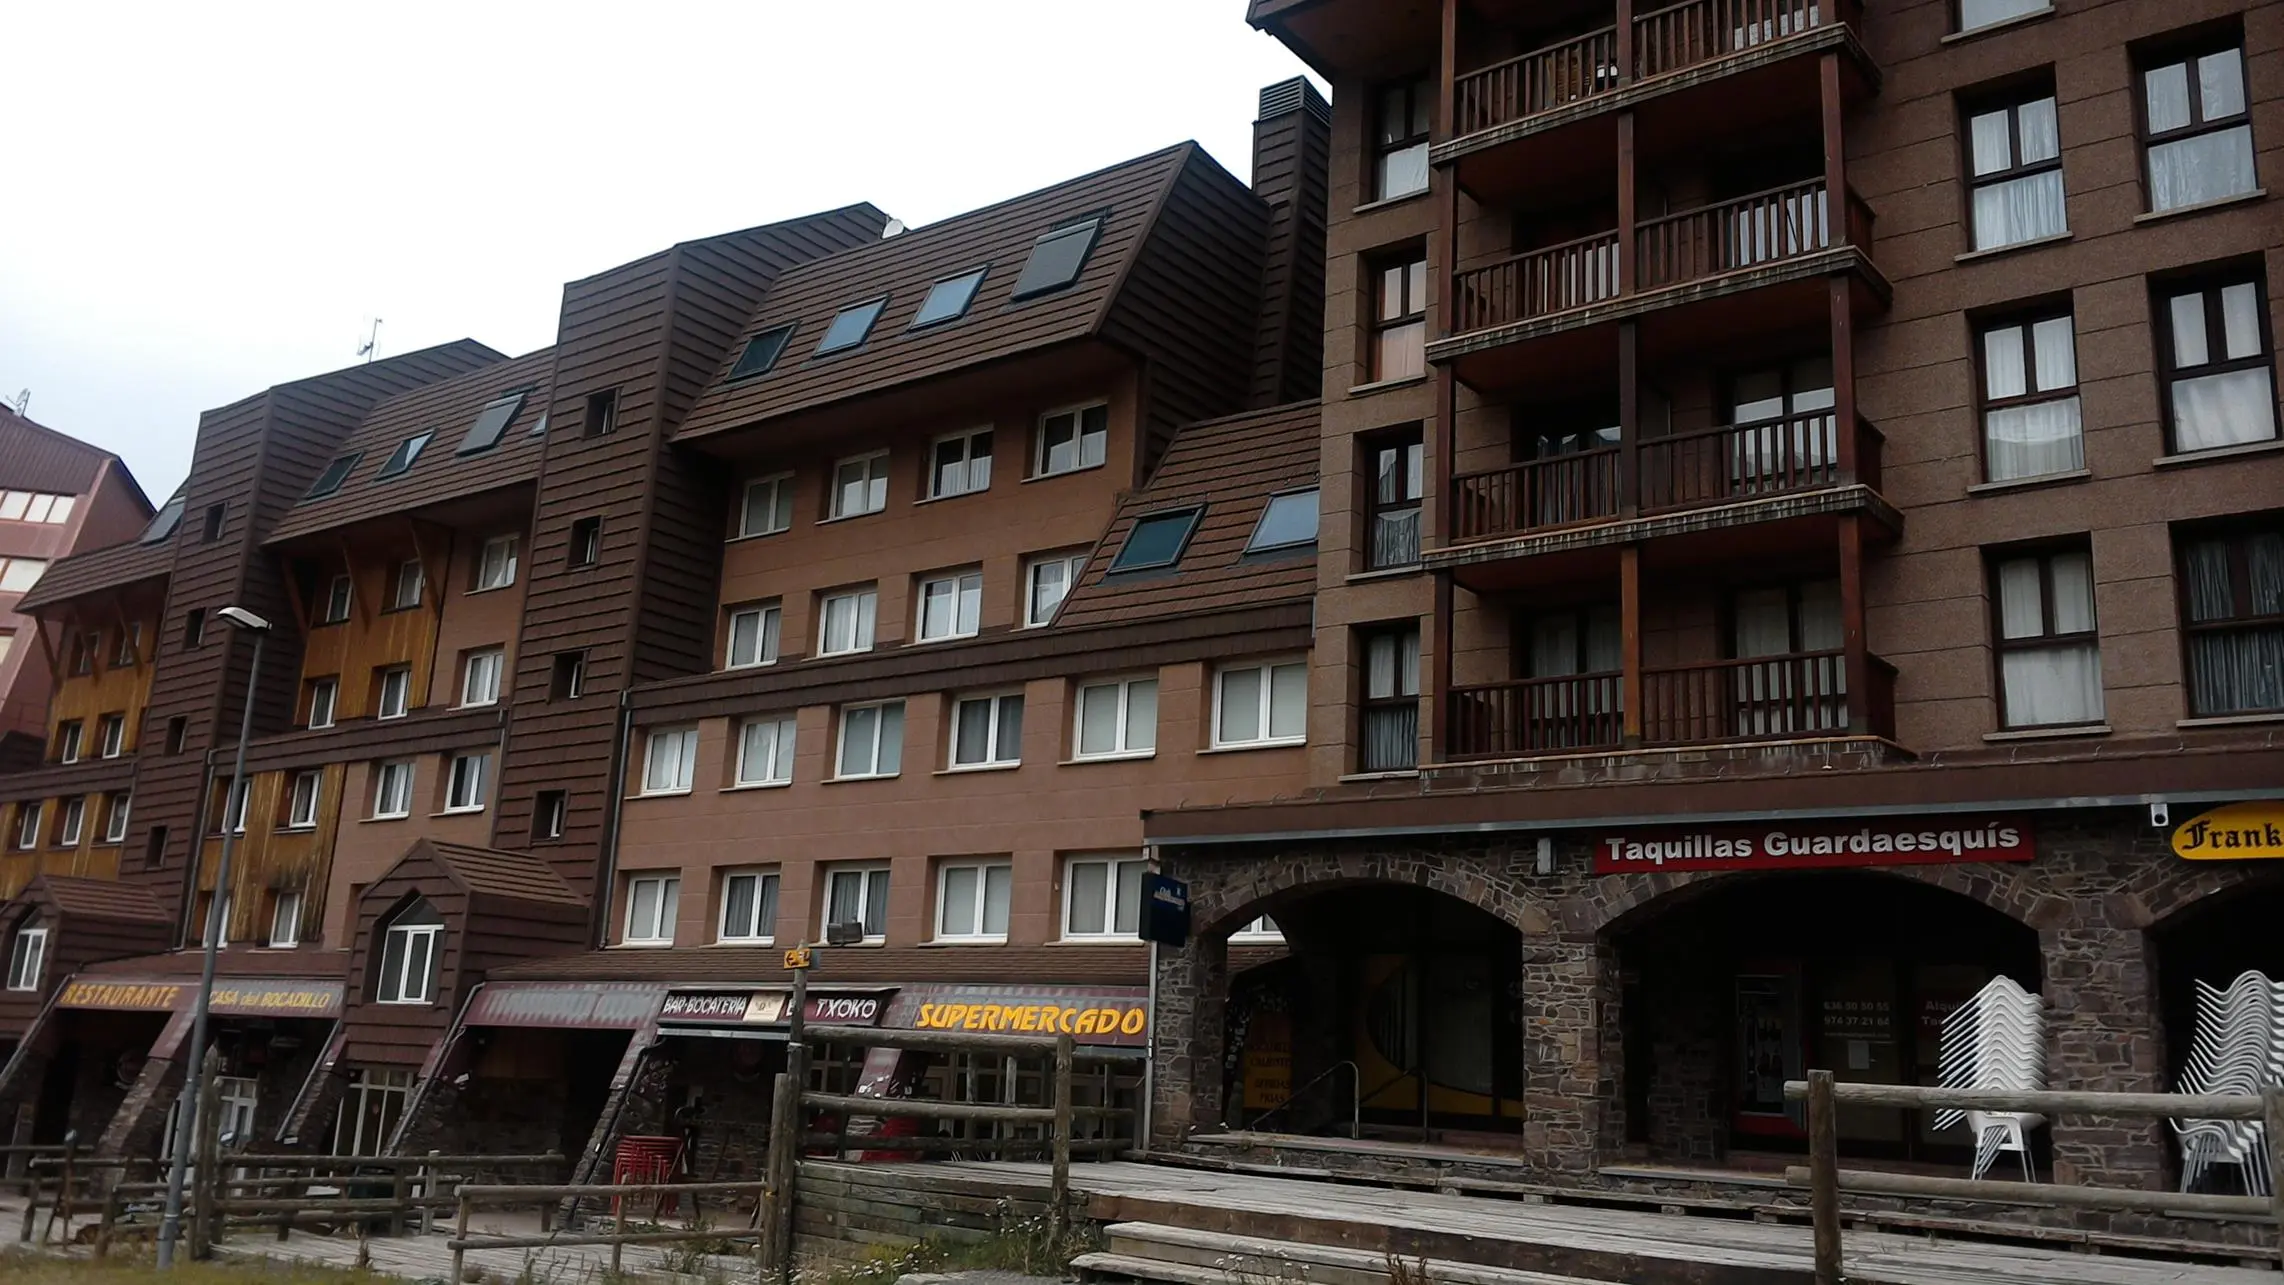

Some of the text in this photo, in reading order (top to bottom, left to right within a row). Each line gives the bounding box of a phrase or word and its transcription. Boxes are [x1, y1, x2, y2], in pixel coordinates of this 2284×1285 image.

[1606, 821, 2020, 865] Taquillas Guardaesquís
[2181, 819, 2283, 850] Frank
[59, 982, 180, 1009] RESTAURANTE
[209, 989, 239, 1005] CASA
[260, 991, 332, 1009] BOCADILLO
[814, 997, 878, 1018] TXOKO
[916, 1002, 1146, 1036] SUPERMERCADO
